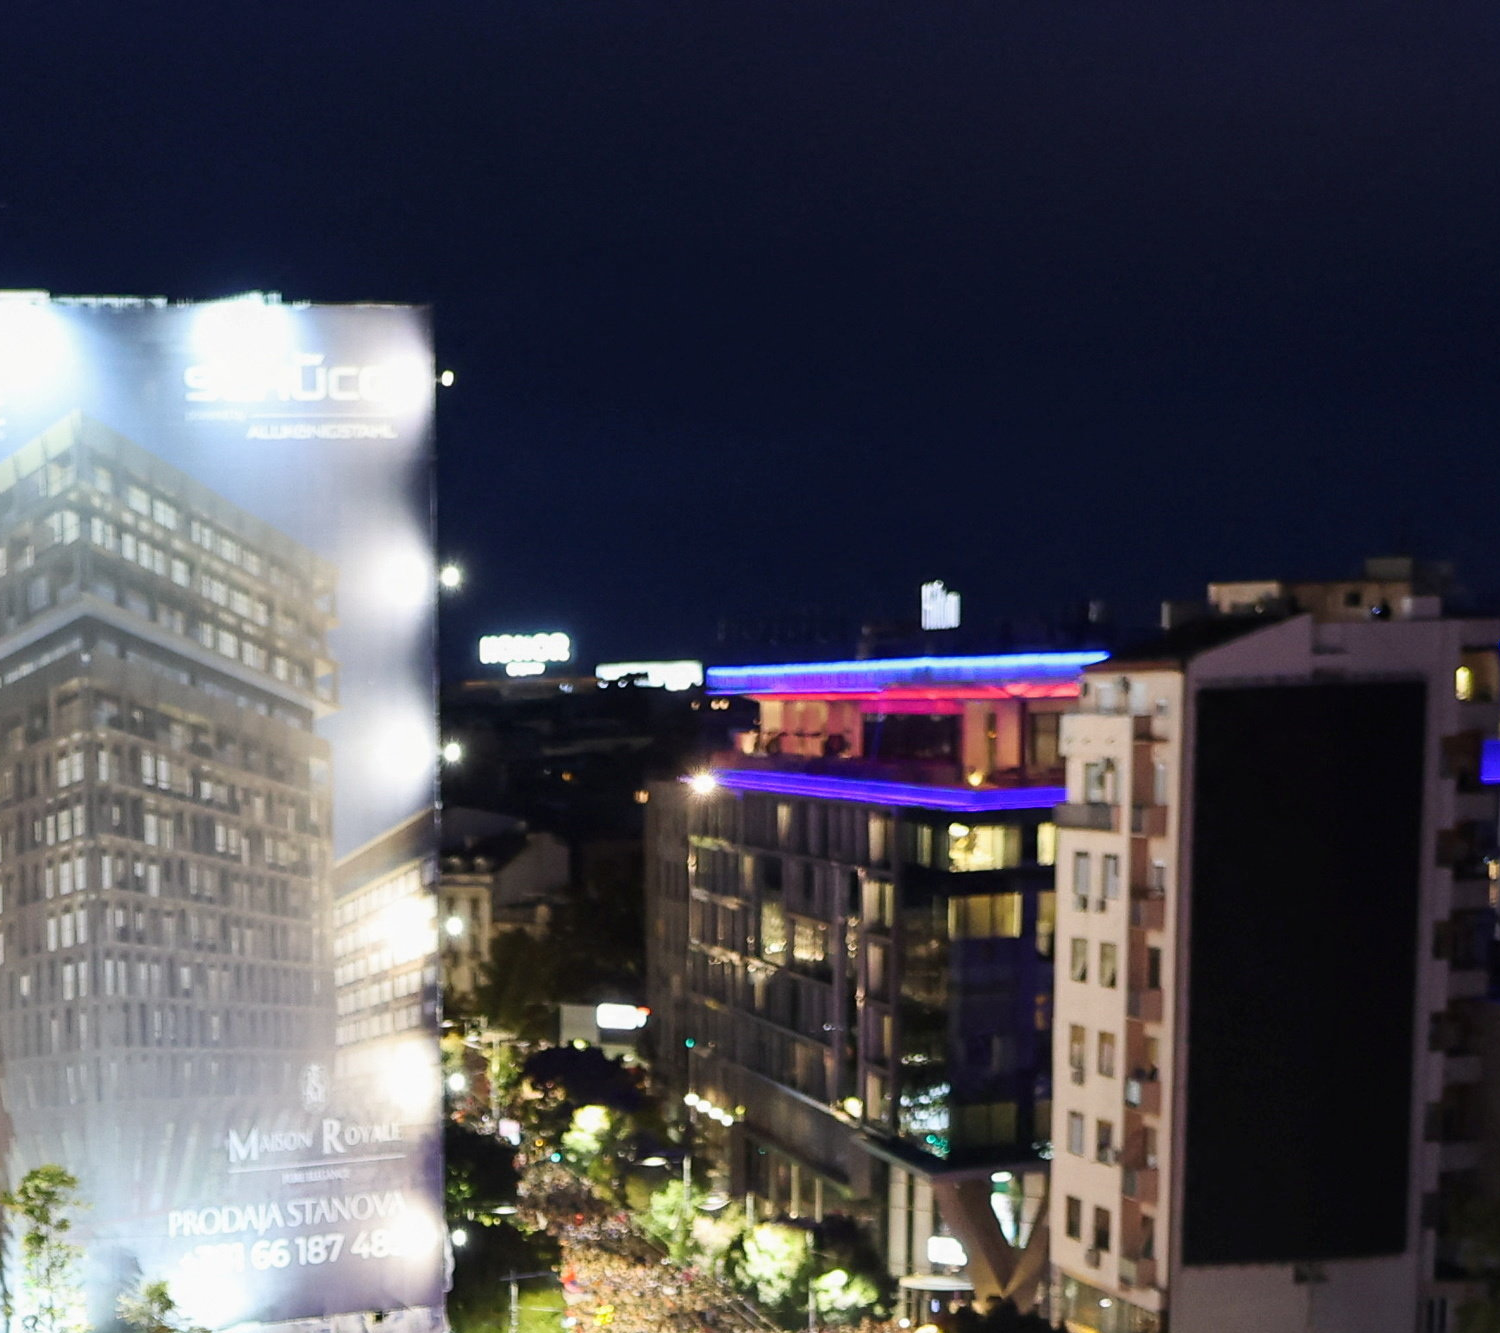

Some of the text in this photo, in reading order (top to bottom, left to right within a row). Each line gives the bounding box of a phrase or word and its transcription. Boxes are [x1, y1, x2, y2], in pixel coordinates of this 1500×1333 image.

[168, 1189, 408, 1239] PRODAJA STANOVA
[250, 1238, 292, 1271] 66
[294, 1232, 346, 1266] 187
